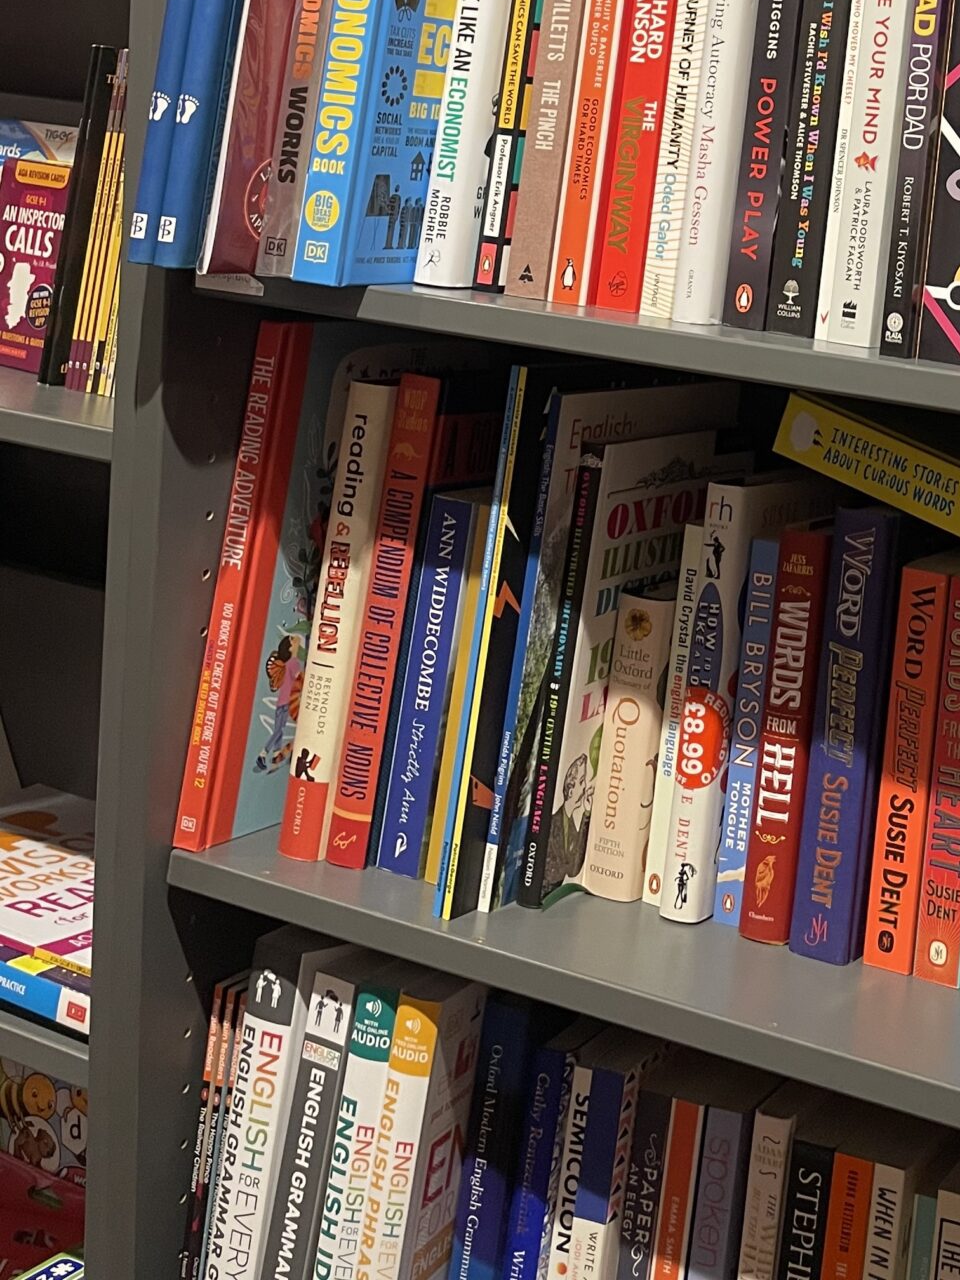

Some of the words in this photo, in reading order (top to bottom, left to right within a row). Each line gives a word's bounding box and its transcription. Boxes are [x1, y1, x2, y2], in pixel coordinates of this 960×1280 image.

[459, 6, 478, 38] LIKE
[819, 11, 831, 47] Wish
[455, 48, 471, 73] AN
[817, 52, 826, 69] I'd
[544, 80, 560, 105] THE
[809, 74, 825, 126] Known
[436, 76, 467, 182] ECONOMIST
[535, 108, 557, 150] PINCH
[748, 77, 776, 181] POWER
[805, 130, 819, 171] When
[312, 158, 345, 175] BOOK
[3, 205, 18, 221] AN
[19, 206, 65, 231] INSPECTOR
[424, 189, 440, 244] MOCHRIE
[437, 196, 451, 240] ROBBIE
[741, 191, 762, 260] PLAY
[800, 185, 813, 218] Was
[5, 225, 54, 258] CALLS
[791, 221, 809, 268] Young
[252, 354, 274, 386] THE
[233, 391, 270, 466] READING
[831, 427, 910, 474] INTERESTING
[913, 467, 960, 497] STORIES
[221, 469, 257, 569] ADVENTURE
[434, 512, 455, 559] ANN
[746, 571, 774, 629] BILL
[414, 564, 450, 710] WIDDECOMBE
[769, 601, 810, 710] WORDS
[732, 641, 764, 767] BRYSON
[767, 718, 796, 733] FROM
[400, 718, 425, 780] Strictly
[604, 697, 640, 831] Quotations
[677, 705, 707, 773] £8.99
[395, 783, 418, 824] Ann
[757, 740, 796, 826] HELL
[351, 1031, 389, 1049] AUDIO
[230, 1024, 255, 1132] ENGLISH
[208, 1133, 239, 1228] GRAMMAR
[468, 1157, 487, 1210] English
[555, 1092, 591, 1253] SEMICOLON
